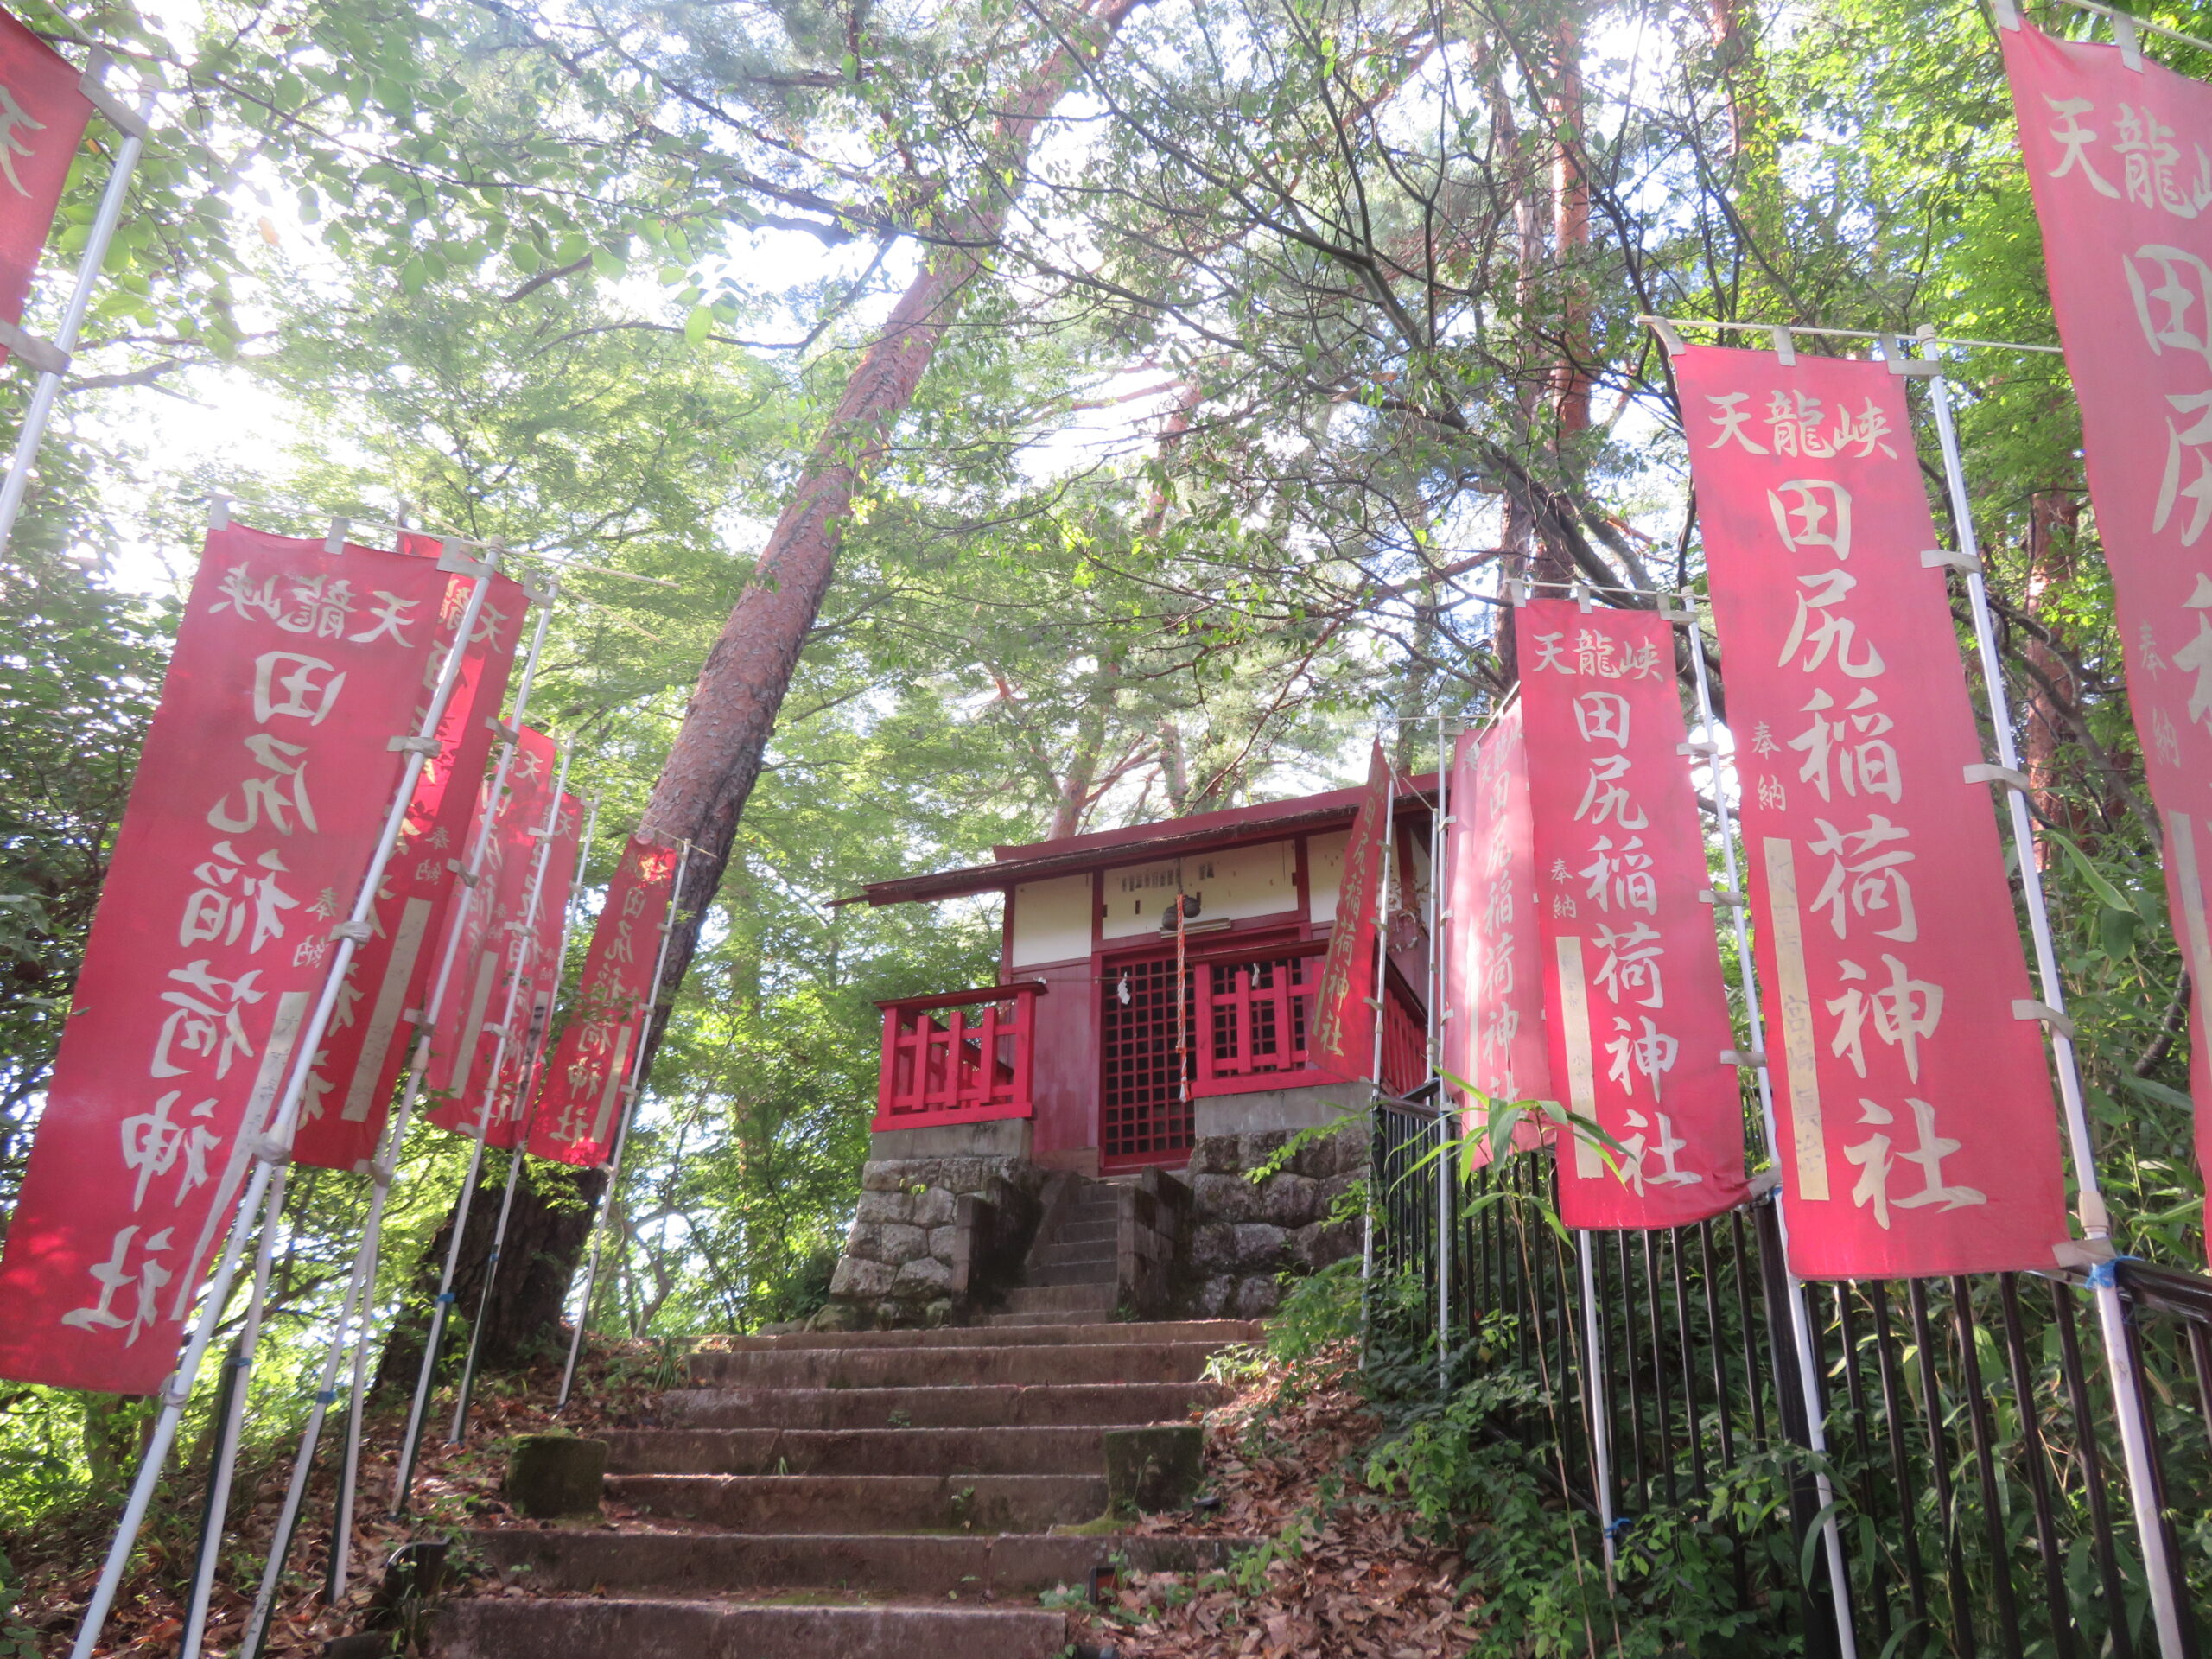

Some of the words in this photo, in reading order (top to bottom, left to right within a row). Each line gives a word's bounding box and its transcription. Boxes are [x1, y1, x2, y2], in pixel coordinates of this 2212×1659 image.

[1705, 390, 1899, 461] 天龍峡
[1533, 628, 1664, 683] 天龍峡
[2139, 619, 2181, 769] 奉納
[1751, 720, 1788, 815] 奉納
[1549, 858, 1578, 920] 奉納
[1767, 478, 1987, 1231] 田尻稲荷神社
[1573, 690, 1703, 1199] 田尻稲荷神社
